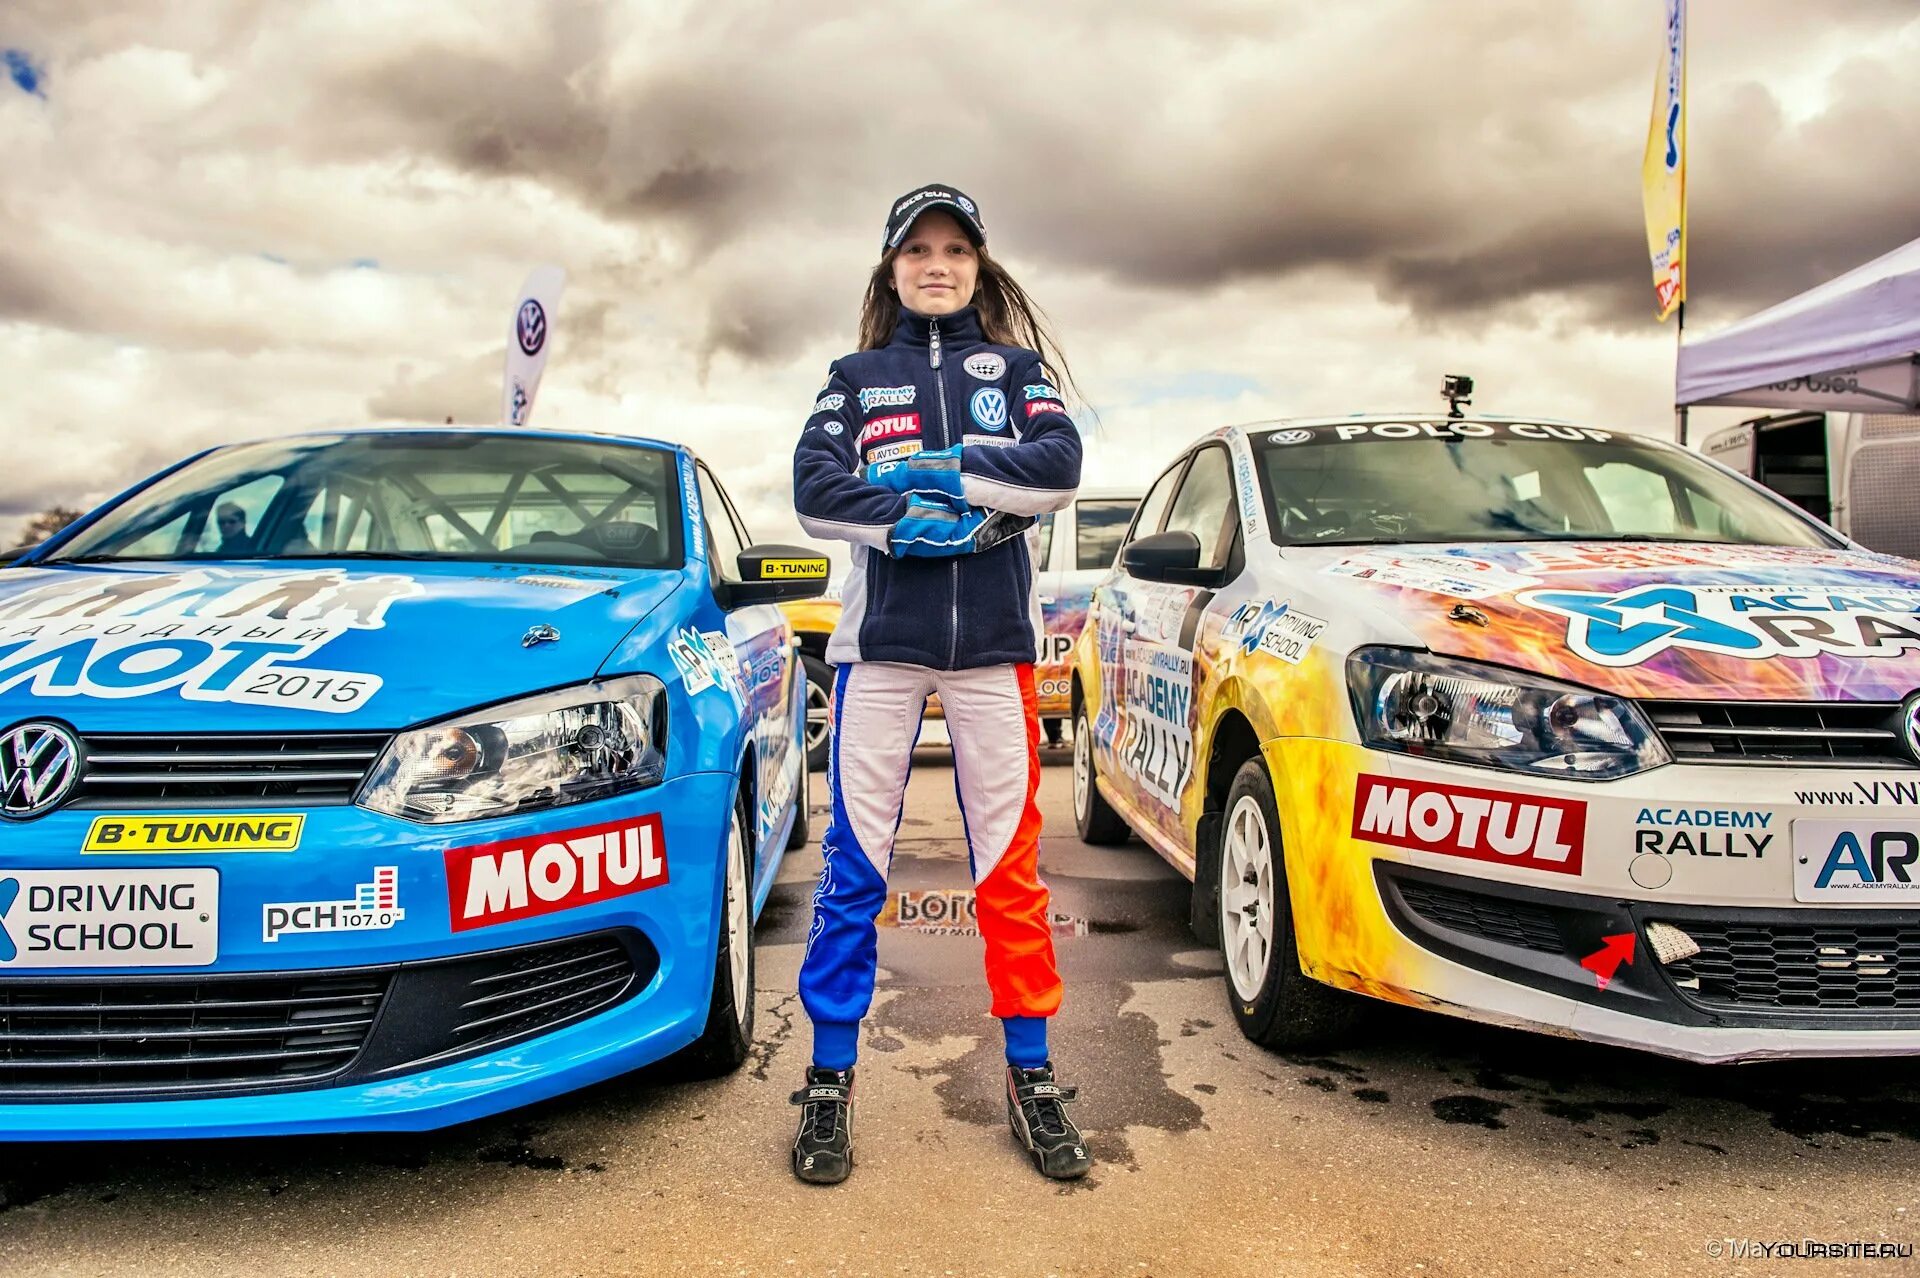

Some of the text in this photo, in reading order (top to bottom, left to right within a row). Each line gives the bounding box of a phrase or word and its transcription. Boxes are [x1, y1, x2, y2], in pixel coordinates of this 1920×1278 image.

[867, 393, 914, 405] RALLY
[1336, 423, 1613, 444] POLO CUP
[1730, 595, 1920, 612] ACAD
[1276, 614, 1324, 640] DRIVING
[1749, 615, 1920, 647] RA
[1261, 632, 1303, 661] SCHOOL
[246, 672, 368, 703] 2015
[1126, 667, 1189, 729] ACADEMY
[1119, 711, 1190, 800] RALLY
[1360, 784, 1573, 862] MOTUL
[1635, 808, 1773, 829] ACADEMY
[1635, 830, 1774, 859] RALLY
[463, 824, 662, 920] MOTUL
[28, 883, 196, 913] DRIVING
[343, 913, 391, 927] 107.0
[28, 923, 194, 952] SCHOOL
